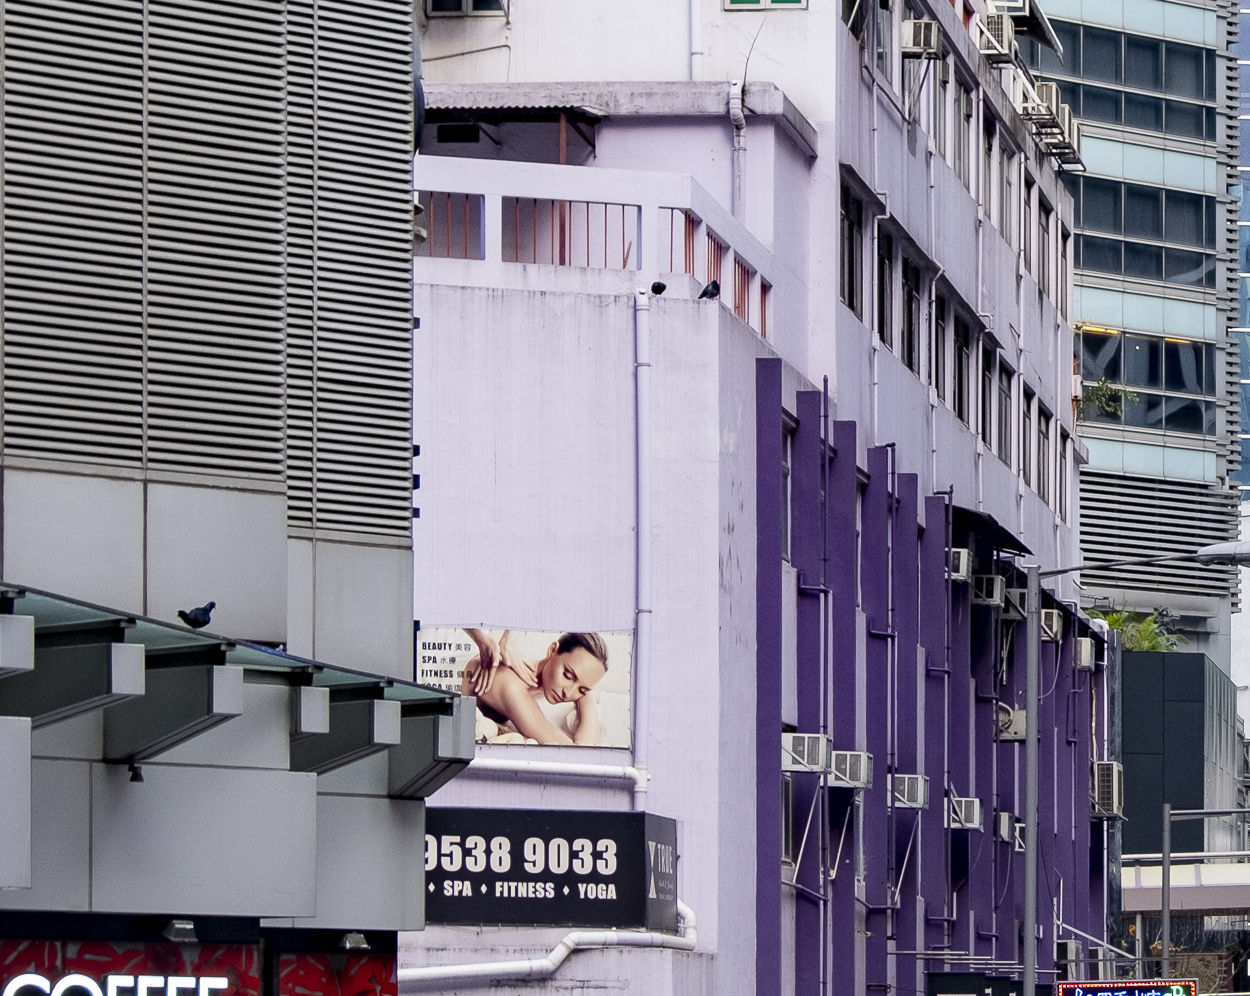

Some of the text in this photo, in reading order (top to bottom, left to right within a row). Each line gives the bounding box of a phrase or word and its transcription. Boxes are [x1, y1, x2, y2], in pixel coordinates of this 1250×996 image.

[422, 642, 452, 651] BEAUTY
[422, 656, 437, 664] SPA
[421, 669, 453, 678] FITNESS
[425, 834, 617, 875] 9538 9033
[657, 843, 673, 875] TRUE
[444, 881, 617, 900] SPA FITNESS YOGA
